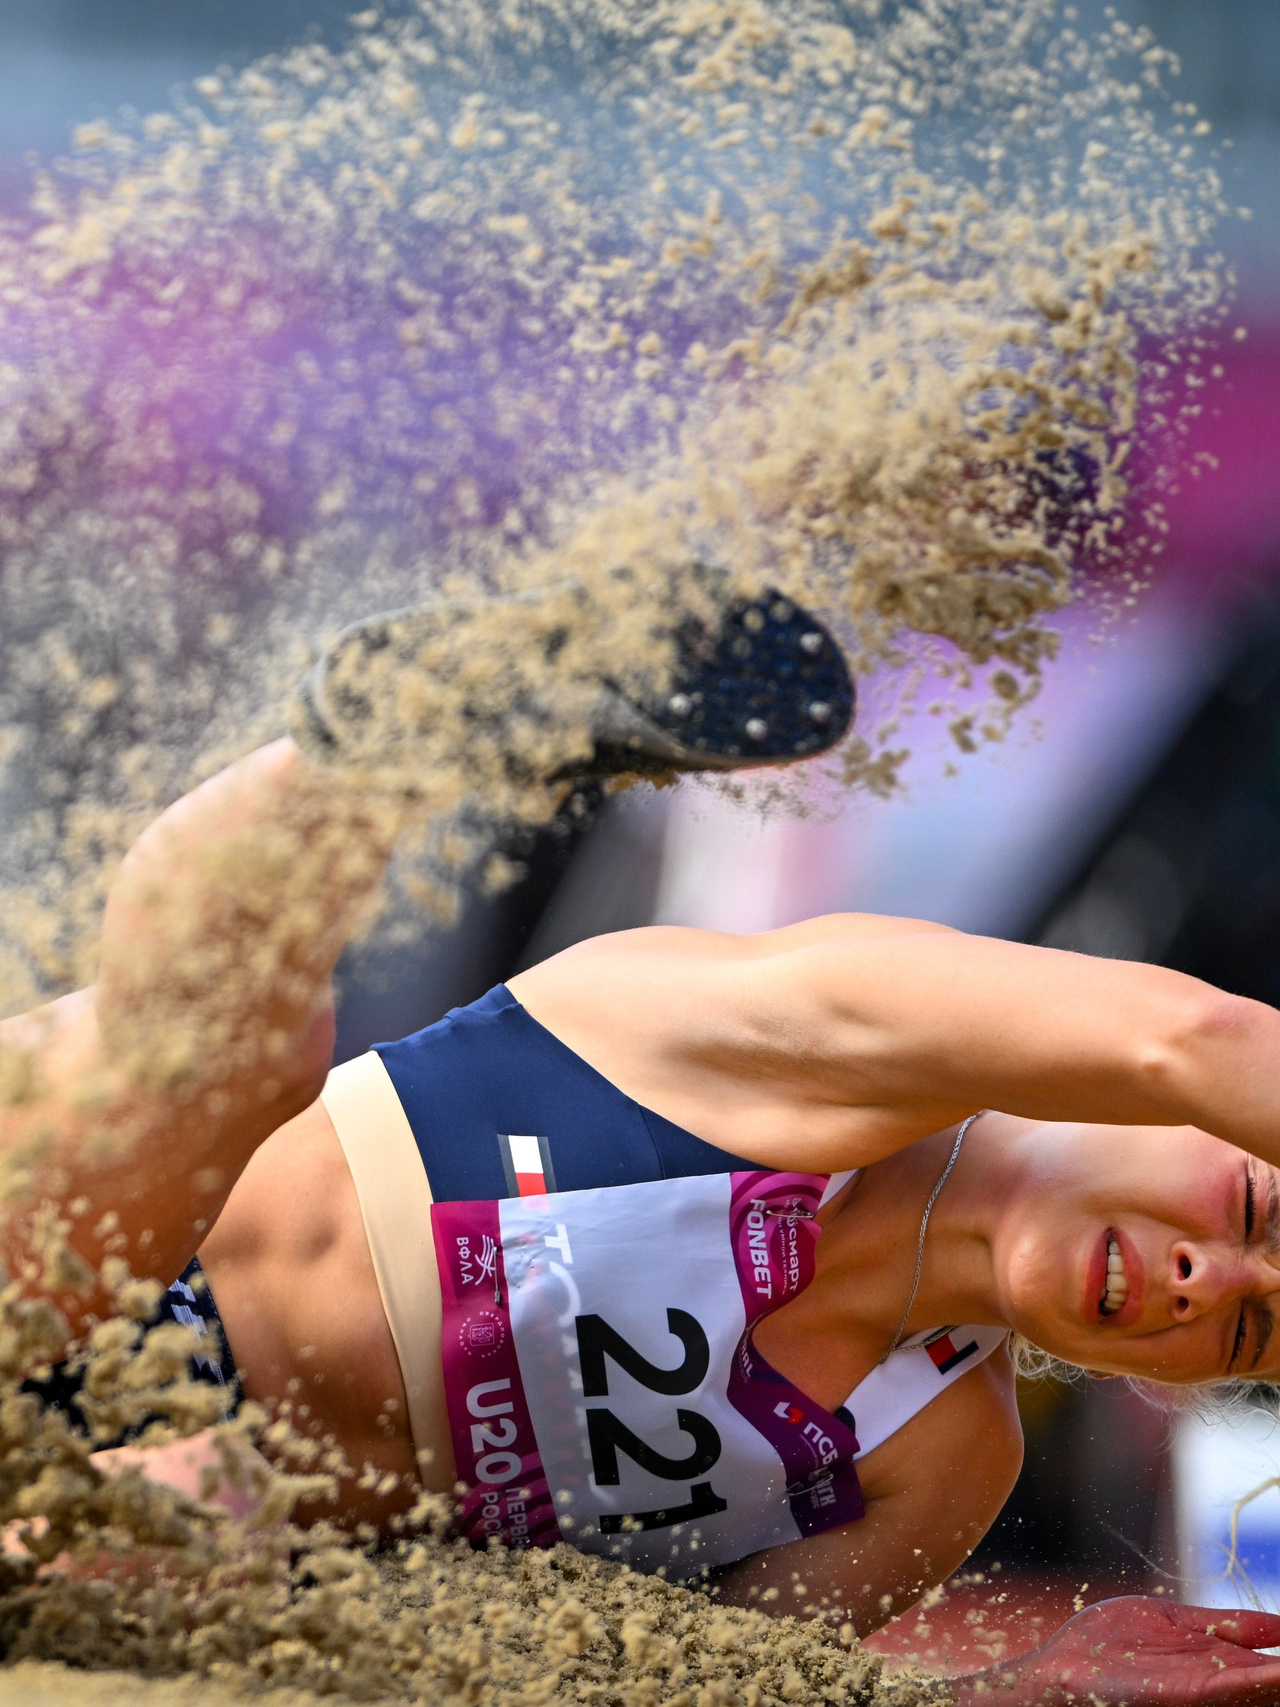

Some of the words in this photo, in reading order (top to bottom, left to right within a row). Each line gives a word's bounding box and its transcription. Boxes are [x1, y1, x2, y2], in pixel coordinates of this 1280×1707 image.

[456, 1236, 474, 1285] ВФЛА
[746, 1199, 772, 1300] FONBET
[465, 1378, 523, 1484] U20
[575, 1307, 728, 1535] 221
[802, 1421, 839, 1466] ПСБ
